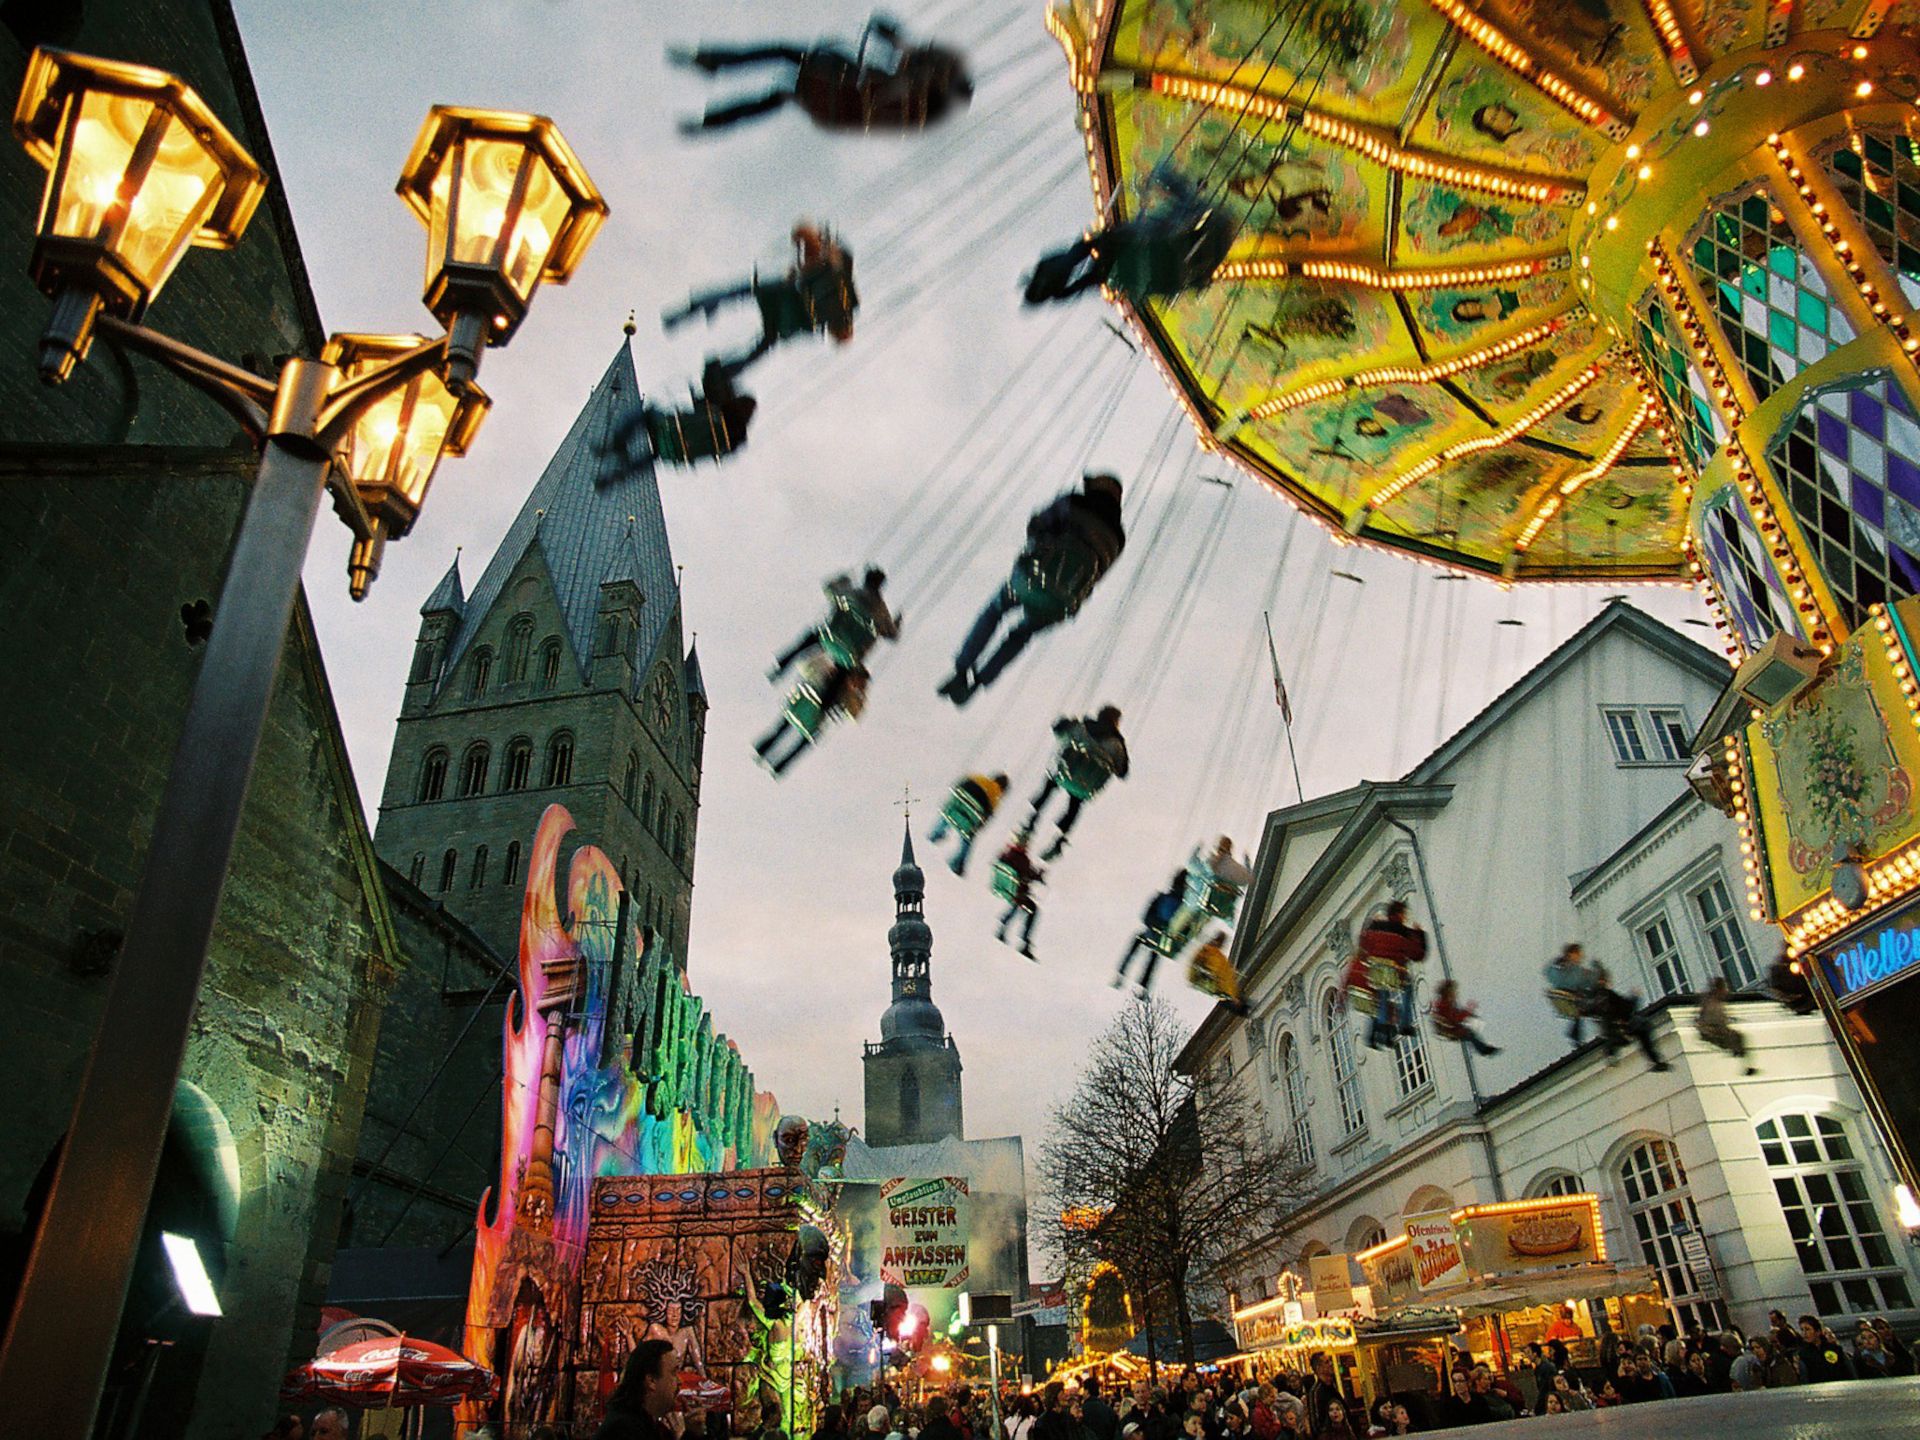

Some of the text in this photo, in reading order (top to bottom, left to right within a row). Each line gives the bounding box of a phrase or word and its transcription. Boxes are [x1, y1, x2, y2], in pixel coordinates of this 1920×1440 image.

[882, 1178, 899, 1195] NEU
[951, 1178, 968, 1195] NEU
[890, 1206, 957, 1228] GEISTER
[1407, 1224, 1451, 1238] Ofenfrische
[883, 1245, 966, 1267] ANFASSEN
[951, 1270, 969, 1287] NEU
